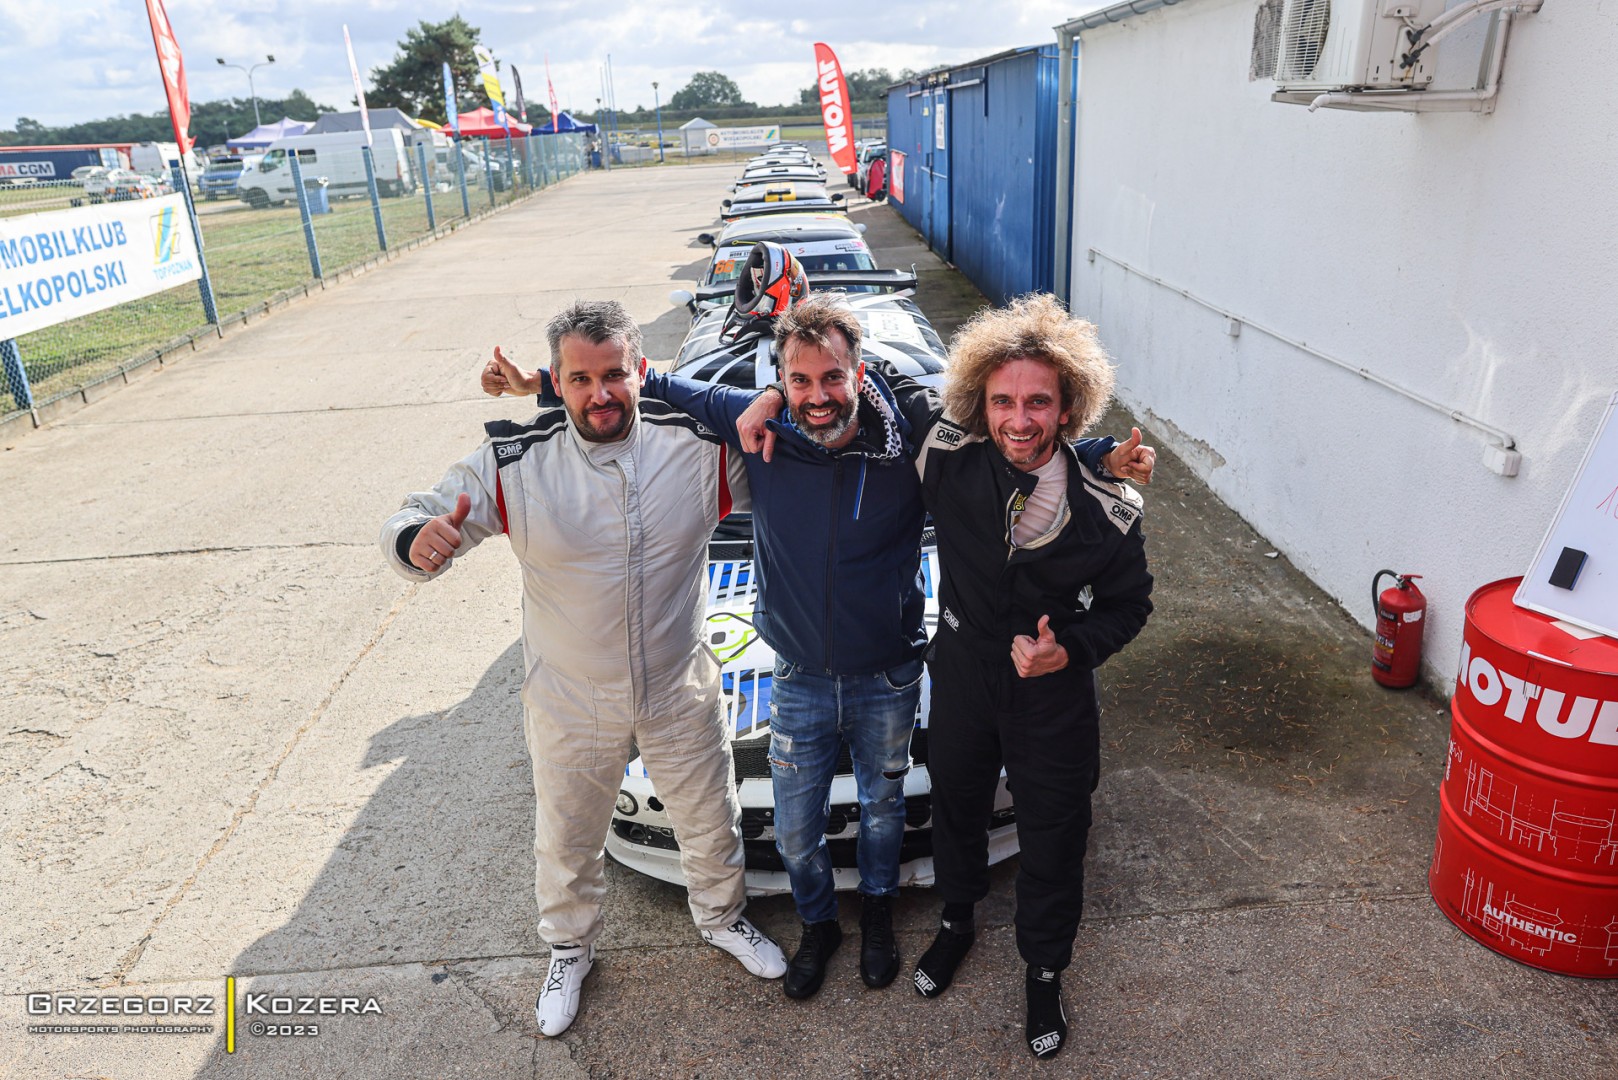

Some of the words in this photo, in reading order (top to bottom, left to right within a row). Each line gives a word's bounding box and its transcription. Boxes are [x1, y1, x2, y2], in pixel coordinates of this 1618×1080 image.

[18, 162, 53, 175] CGM
[714, 259, 735, 275] 66
[936, 428, 961, 445] OMP
[497, 442, 523, 456] OMP
[1111, 503, 1133, 523] OMP
[943, 608, 960, 629] OMP
[1482, 903, 1577, 943] AUTHENTIC
[914, 971, 934, 992] OMP
[1032, 1033, 1061, 1052] OMP
